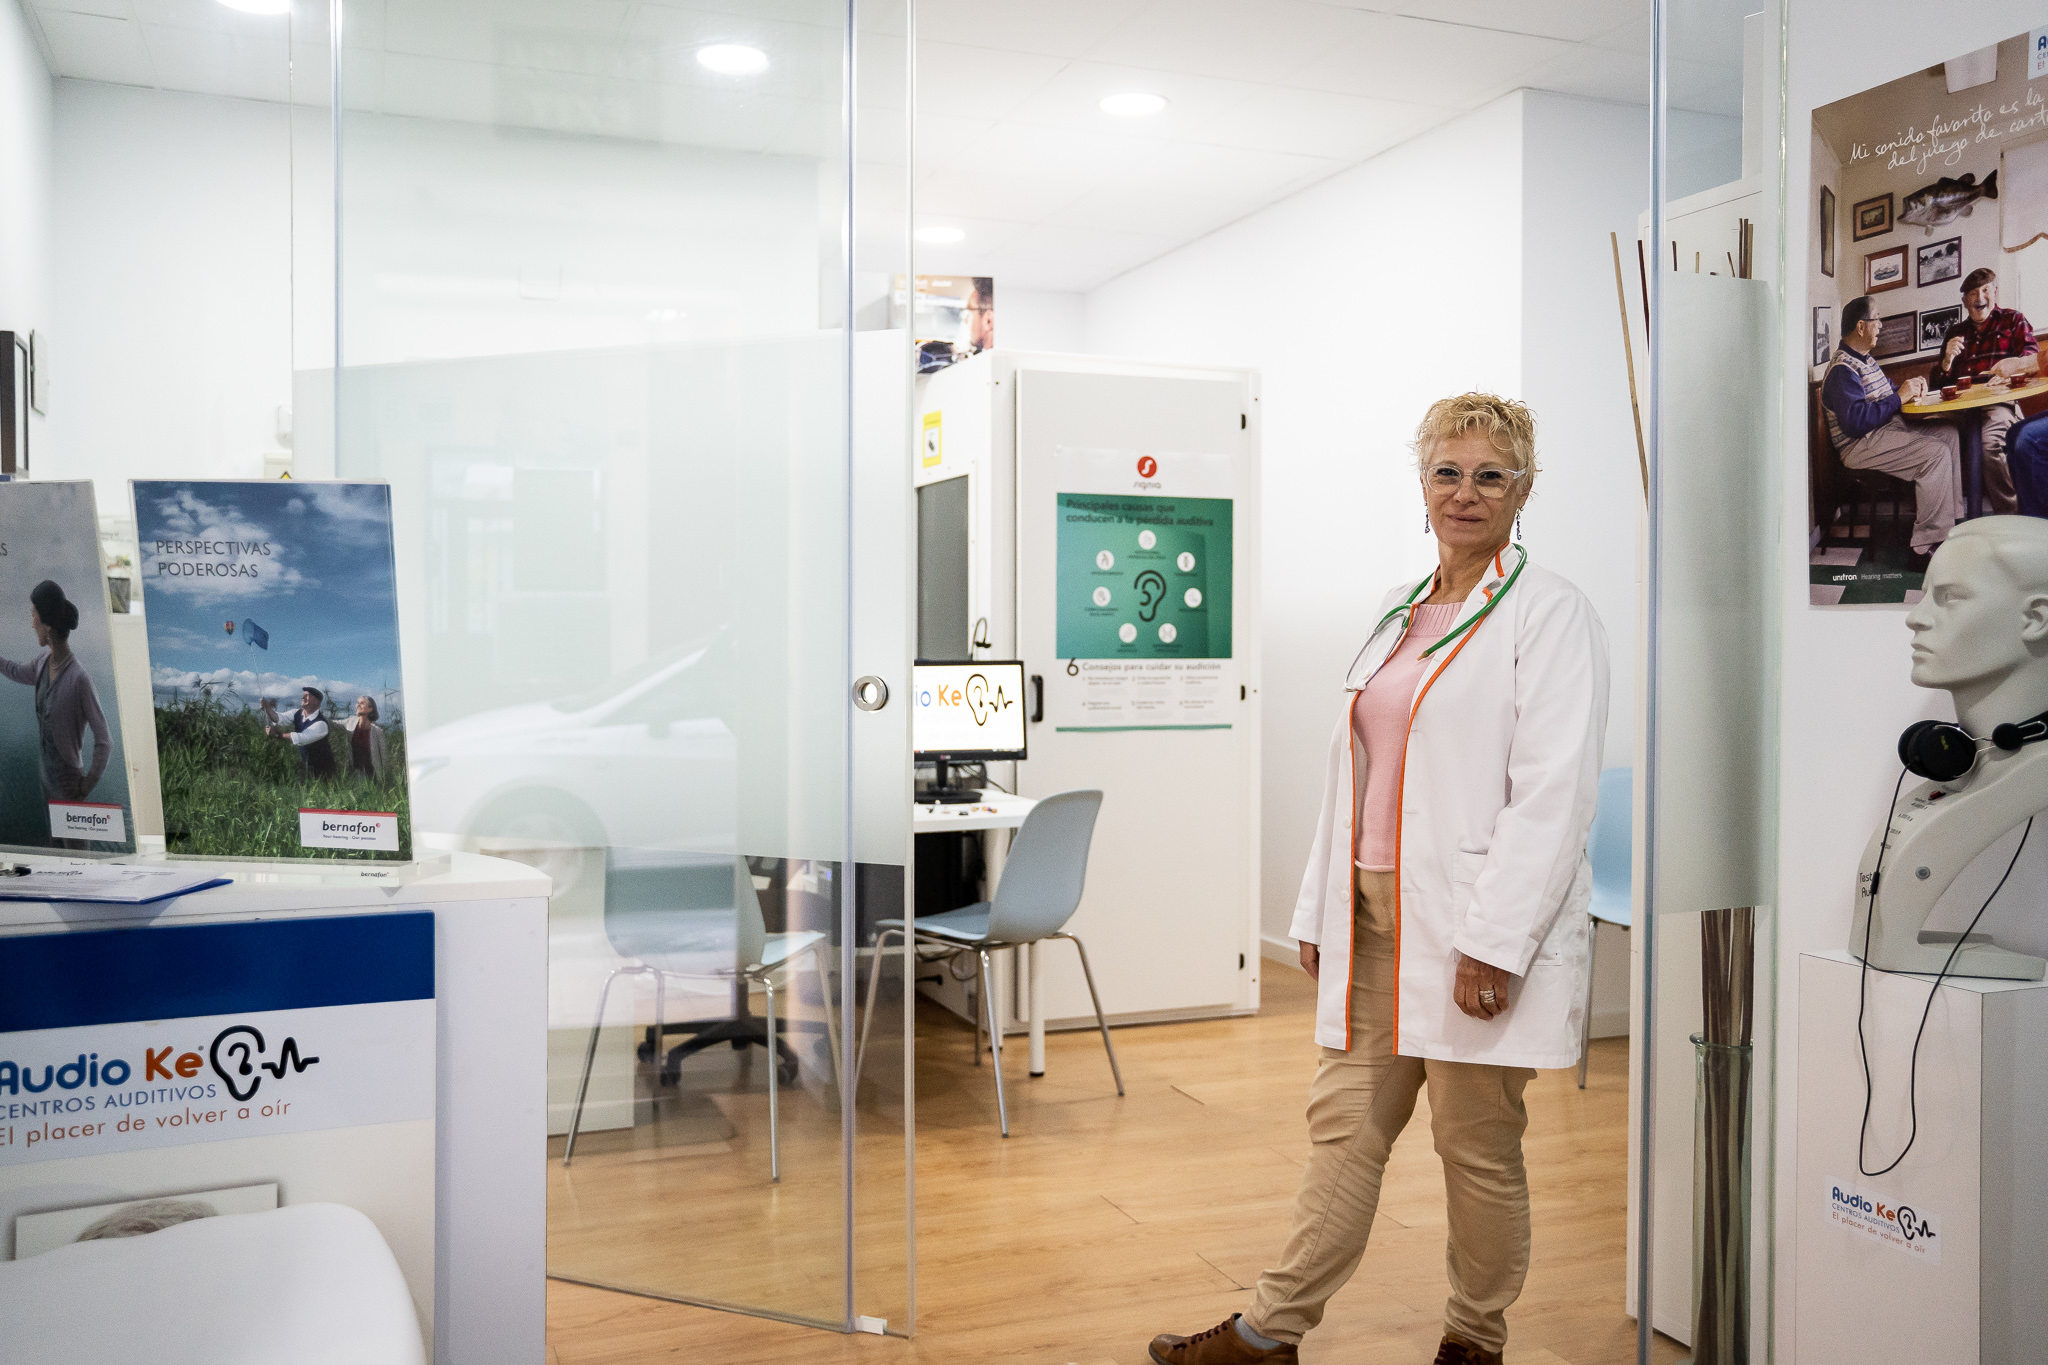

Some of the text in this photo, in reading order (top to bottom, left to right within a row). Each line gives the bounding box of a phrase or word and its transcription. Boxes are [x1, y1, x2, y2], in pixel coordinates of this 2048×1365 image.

[1849, 87, 2045, 164] Mi sonido favorito es la
[1887, 103, 2048, 175] del juego de cart
[156, 540, 271, 556] PERSPECTIVAS
[158, 562, 258, 578] PODEROSAS
[1832, 573, 1857, 581] unitron
[1066, 657, 1079, 677] 6
[938, 684, 962, 707] Ke
[66, 811, 107, 826] bernafon
[322, 820, 376, 835] bernafon
[0, 1046, 204, 1096] Audio Ke
[104, 1083, 217, 1110] AUDITIVOS
[27, 1121, 107, 1148] placer
[116, 1112, 146, 1134] de
[156, 1106, 228, 1128] volver
[238, 1106, 251, 1119] a
[260, 1099, 292, 1117] oír
[1832, 1186, 1896, 1221] Audio Ke
[1831, 1202, 1900, 1234] CENTROS AUDITIVOS
[1832, 1211, 1839, 1221] El
[1841, 1215, 1865, 1230] placer
[1867, 1223, 1877, 1235] de
[1879, 1231, 1904, 1245] volver
